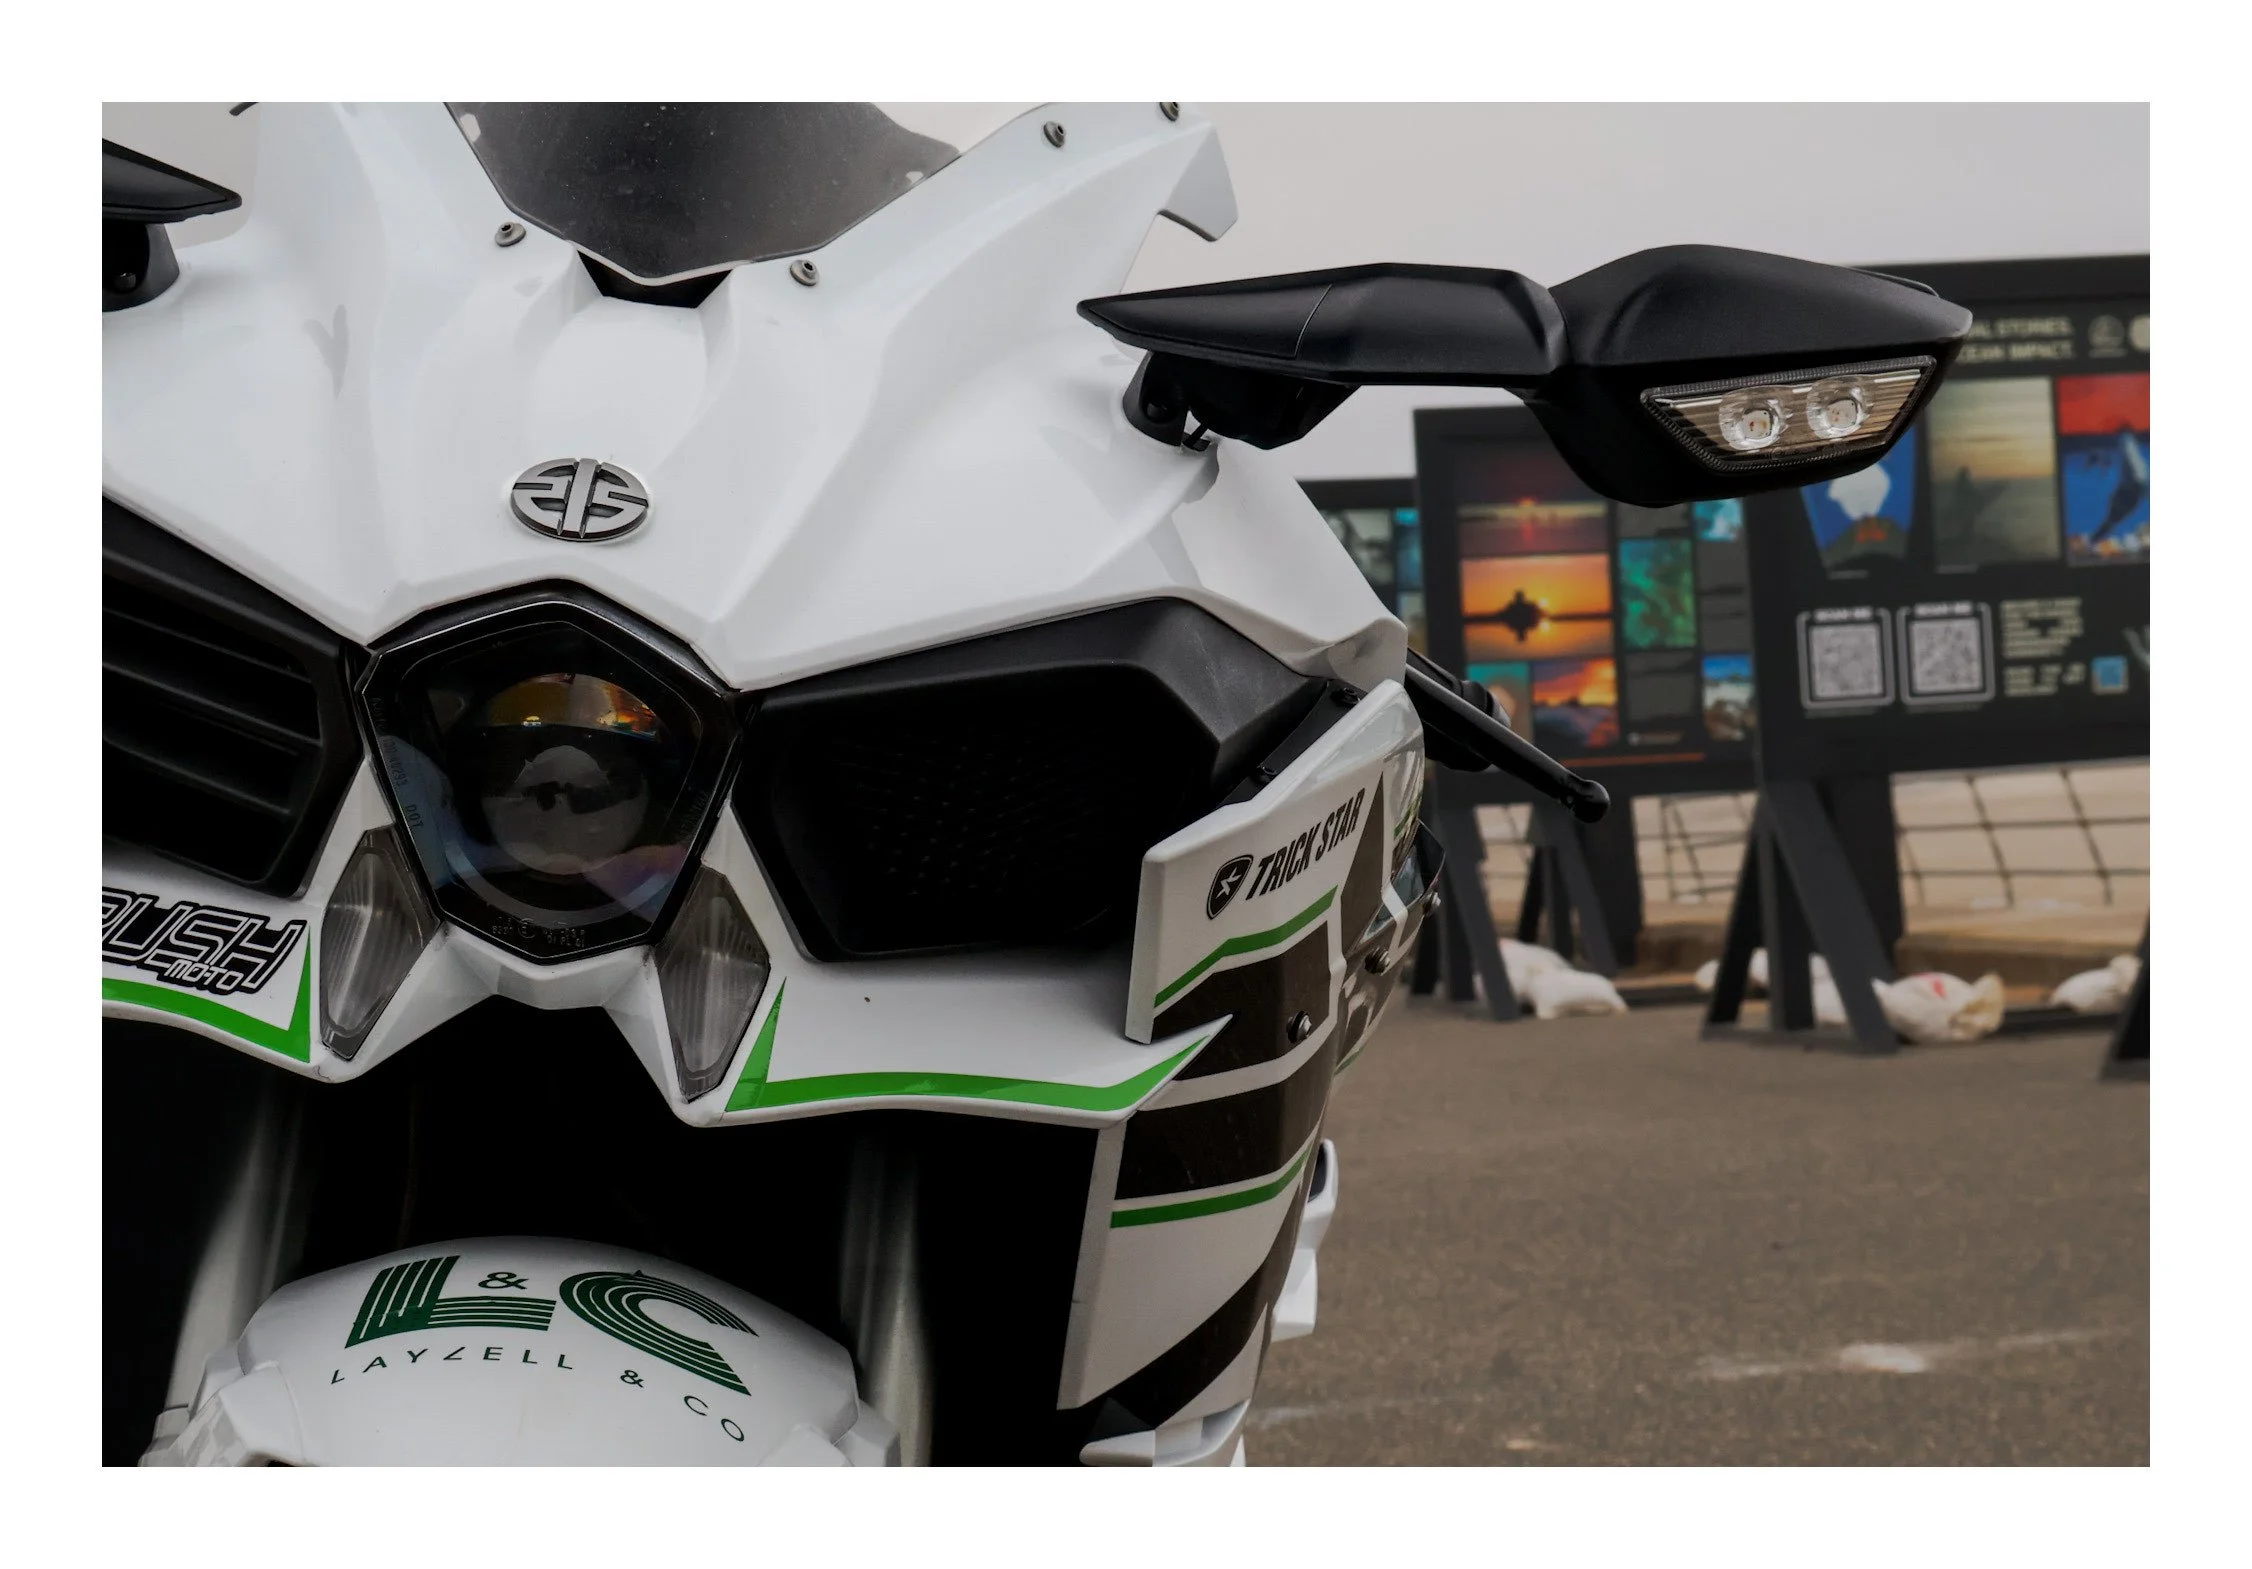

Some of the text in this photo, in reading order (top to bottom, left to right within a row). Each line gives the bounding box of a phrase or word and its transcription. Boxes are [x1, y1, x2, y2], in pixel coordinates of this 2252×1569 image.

[1245, 788, 1366, 901] TRICK STAR
[331, 1346, 745, 1442] LAYZELL & CO
